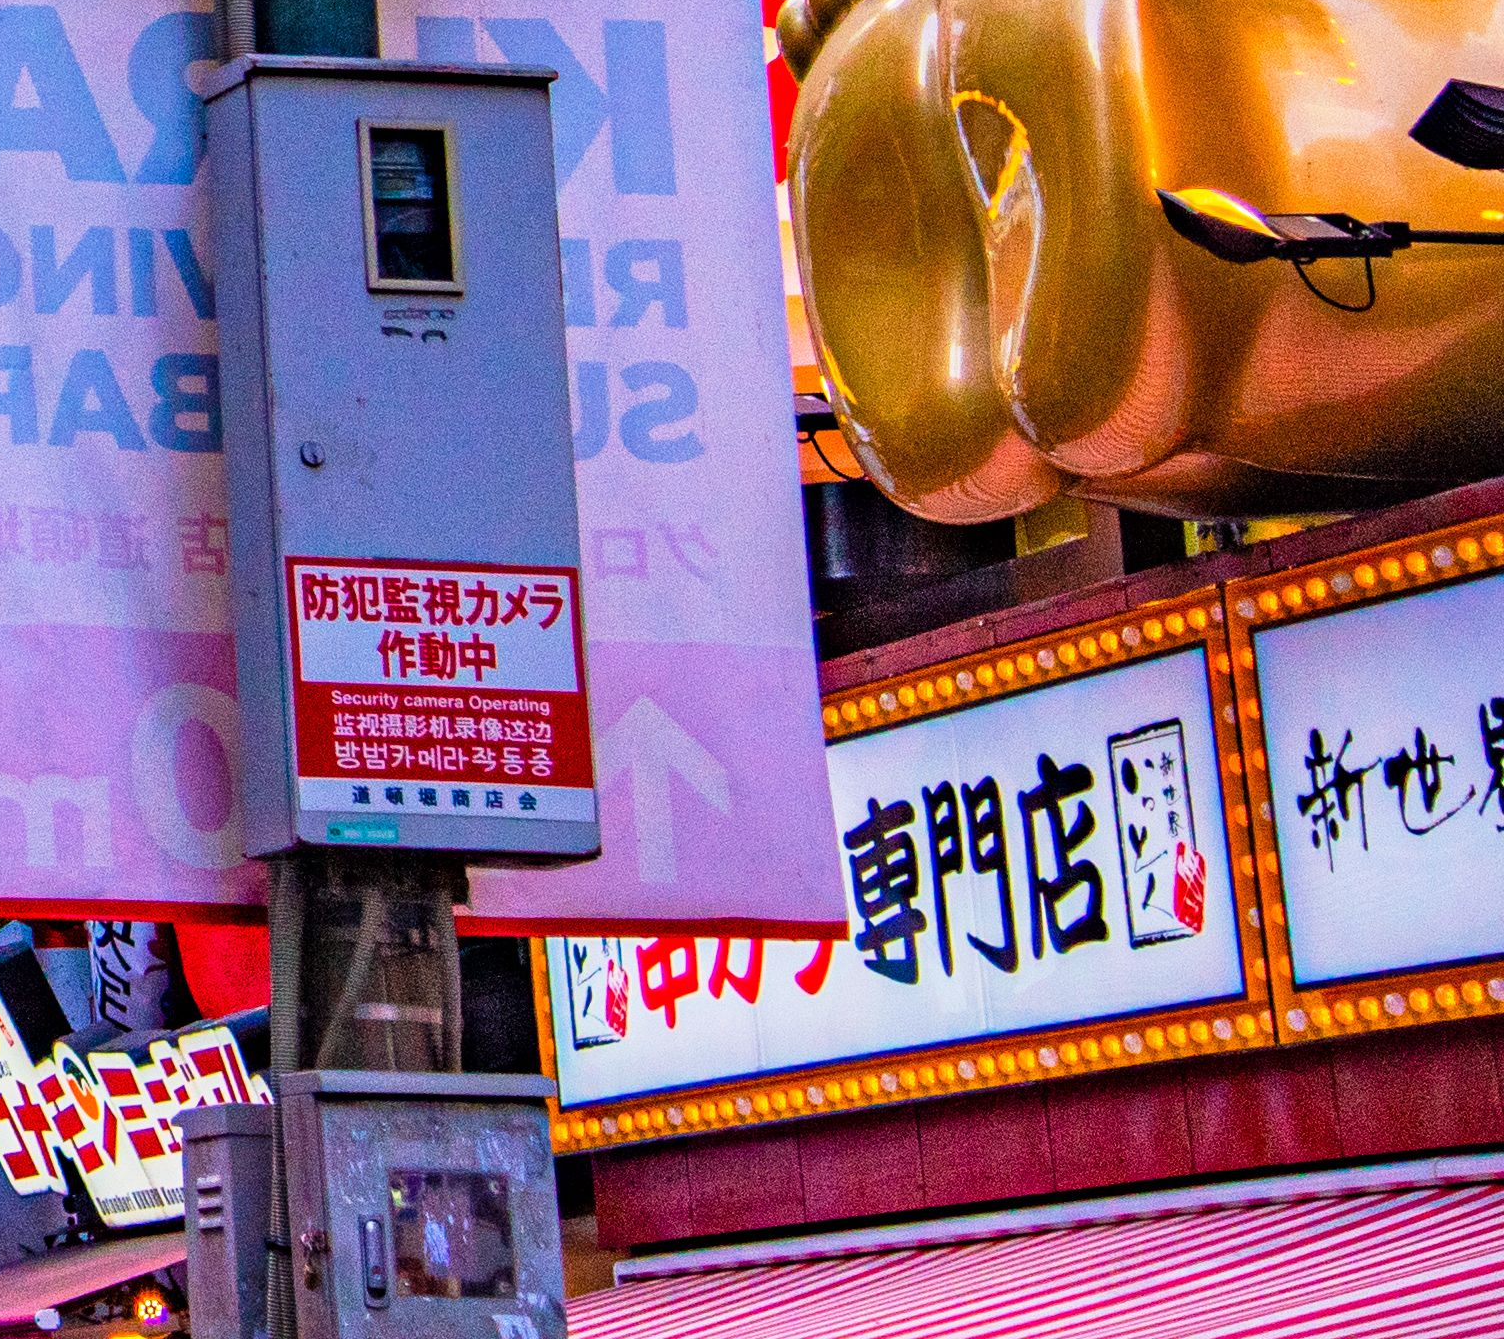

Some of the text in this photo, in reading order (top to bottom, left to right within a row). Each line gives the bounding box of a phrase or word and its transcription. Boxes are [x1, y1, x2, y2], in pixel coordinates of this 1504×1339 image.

[301, 573, 565, 630] 防犯監視カメラ
[377, 630, 497, 682] 作動中
[331, 690, 550, 716] Security camera Operating
[333, 713, 553, 744] 监视摄影机录像这边
[334, 742, 553, 777] 방범카메라작동중
[352, 785, 537, 811] 道頓堀商店会
